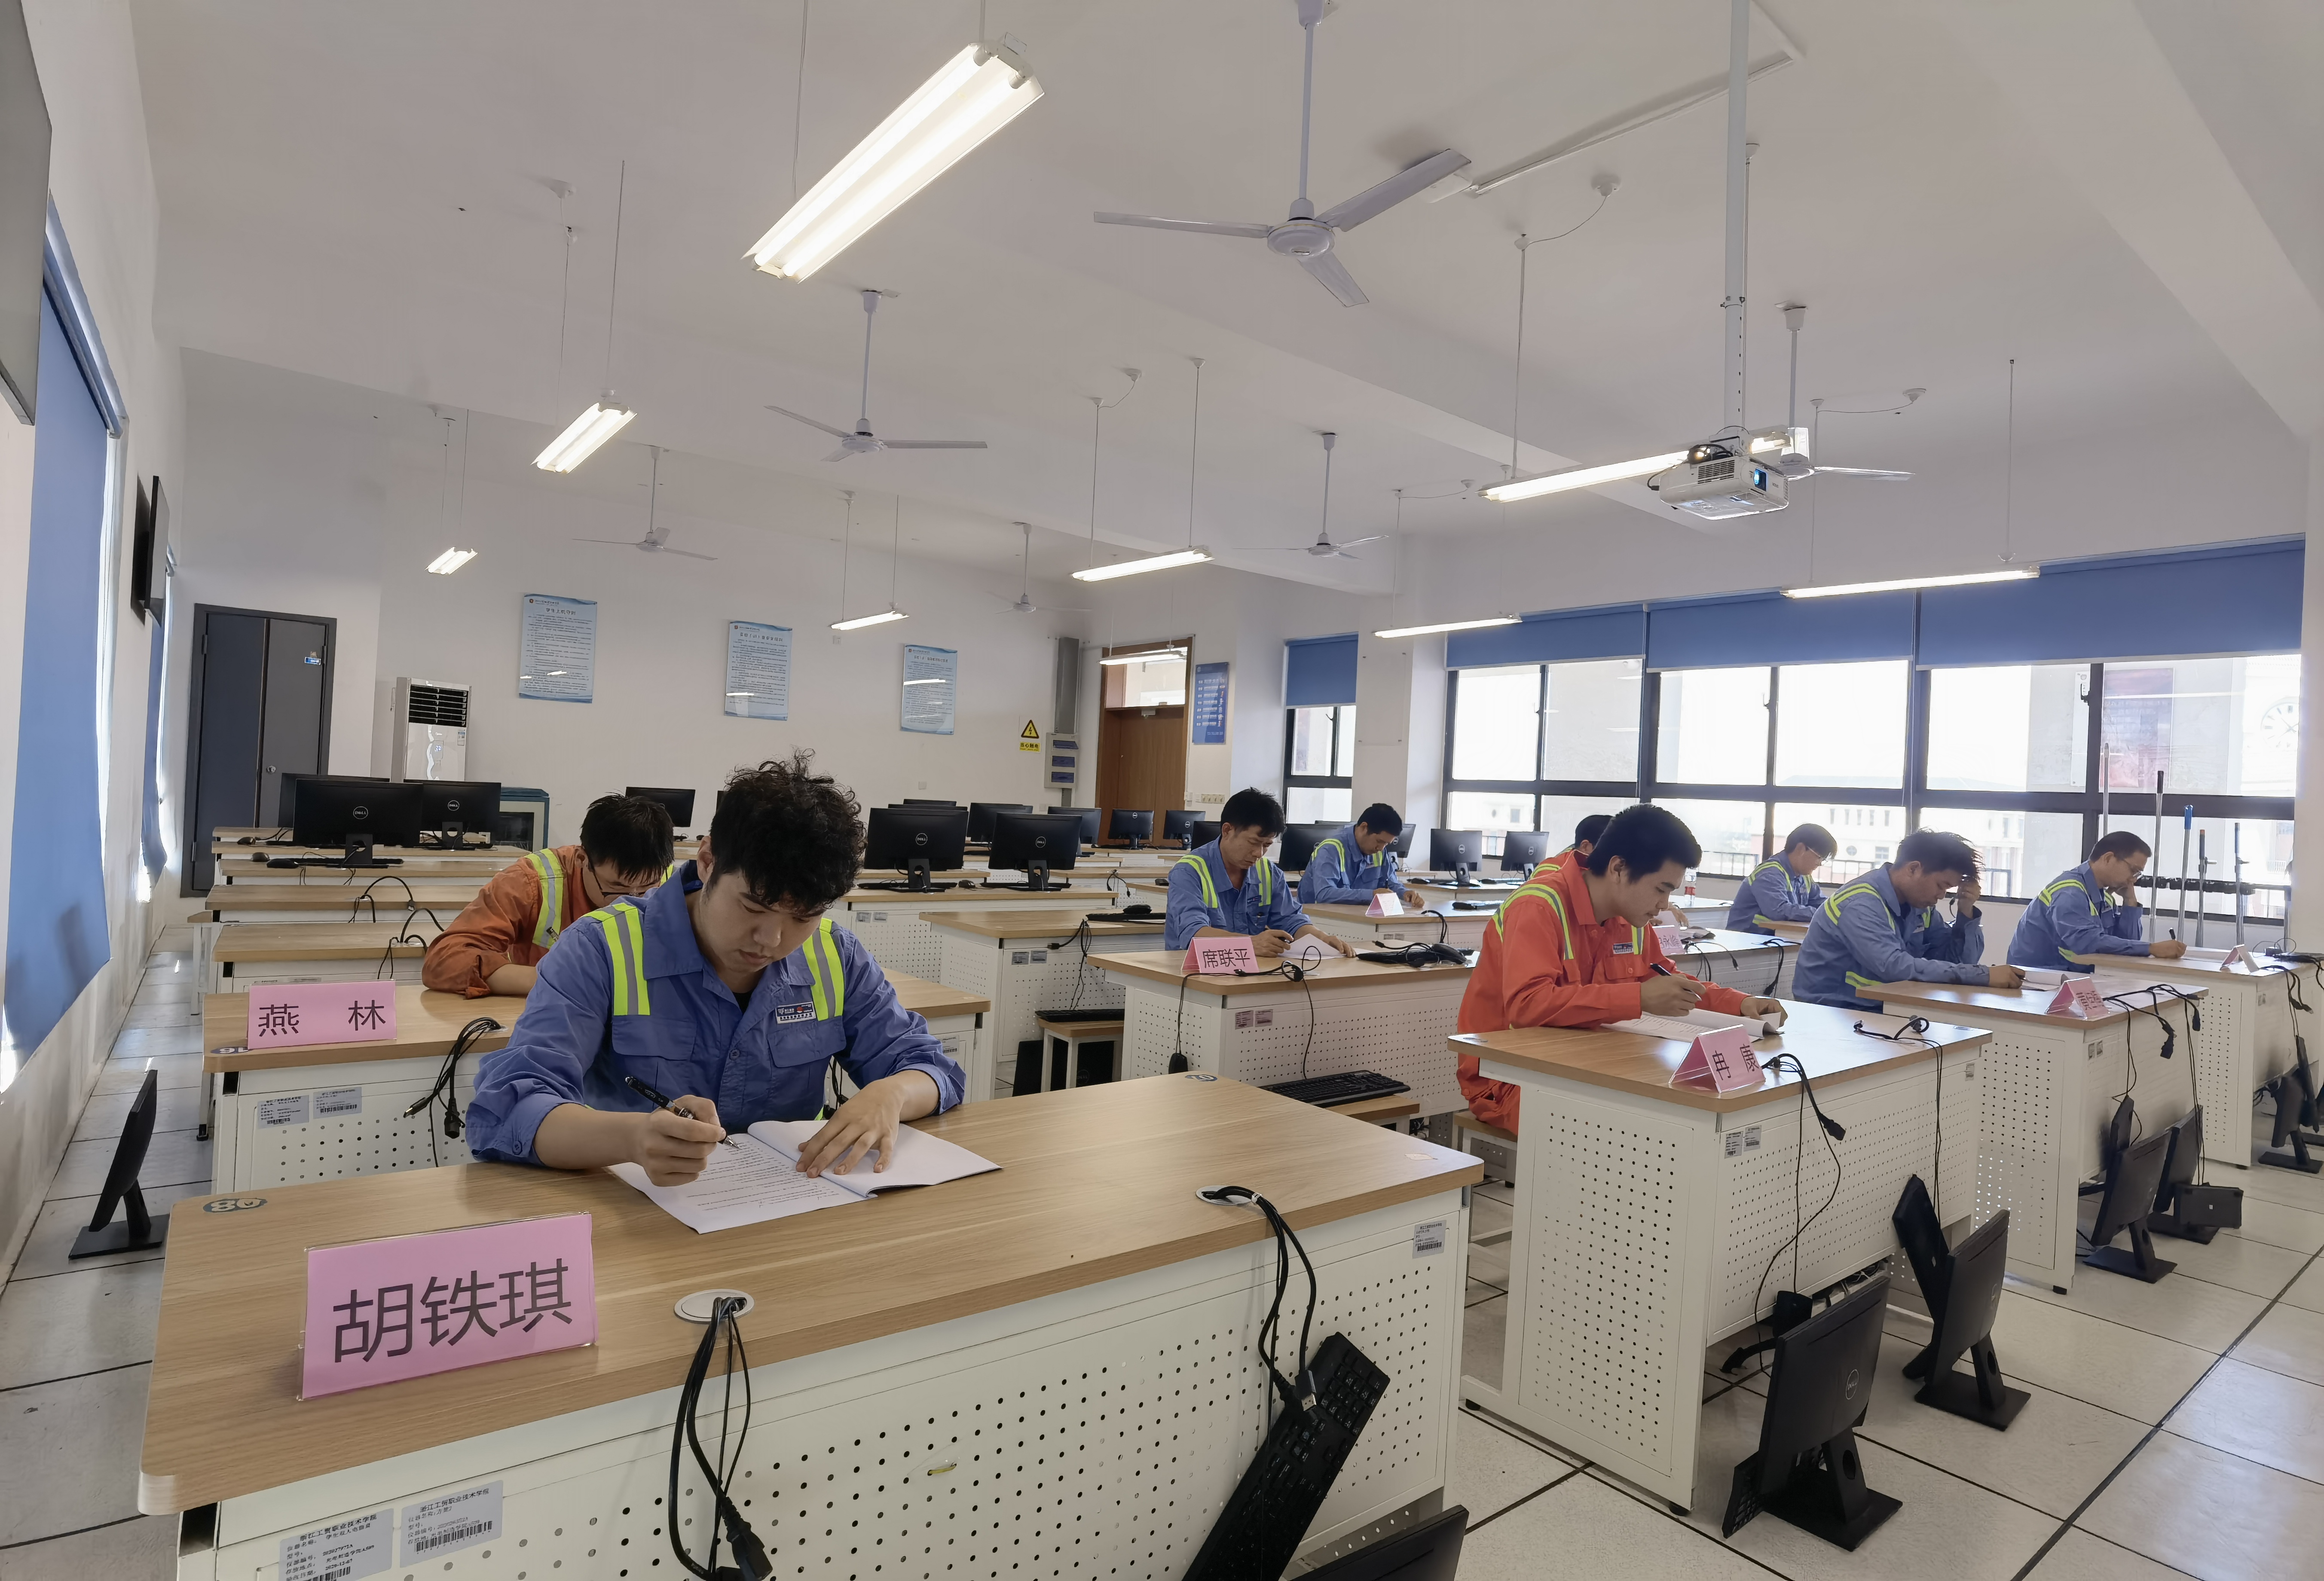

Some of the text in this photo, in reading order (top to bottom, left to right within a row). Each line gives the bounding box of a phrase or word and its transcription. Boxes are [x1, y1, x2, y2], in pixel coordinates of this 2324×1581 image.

[1202, 949, 1250, 968] 席联平
[258, 999, 386, 1037] 燕 林
[1712, 1044, 1760, 1080] 冉 康
[333, 1258, 573, 1363] 胡铁琪
